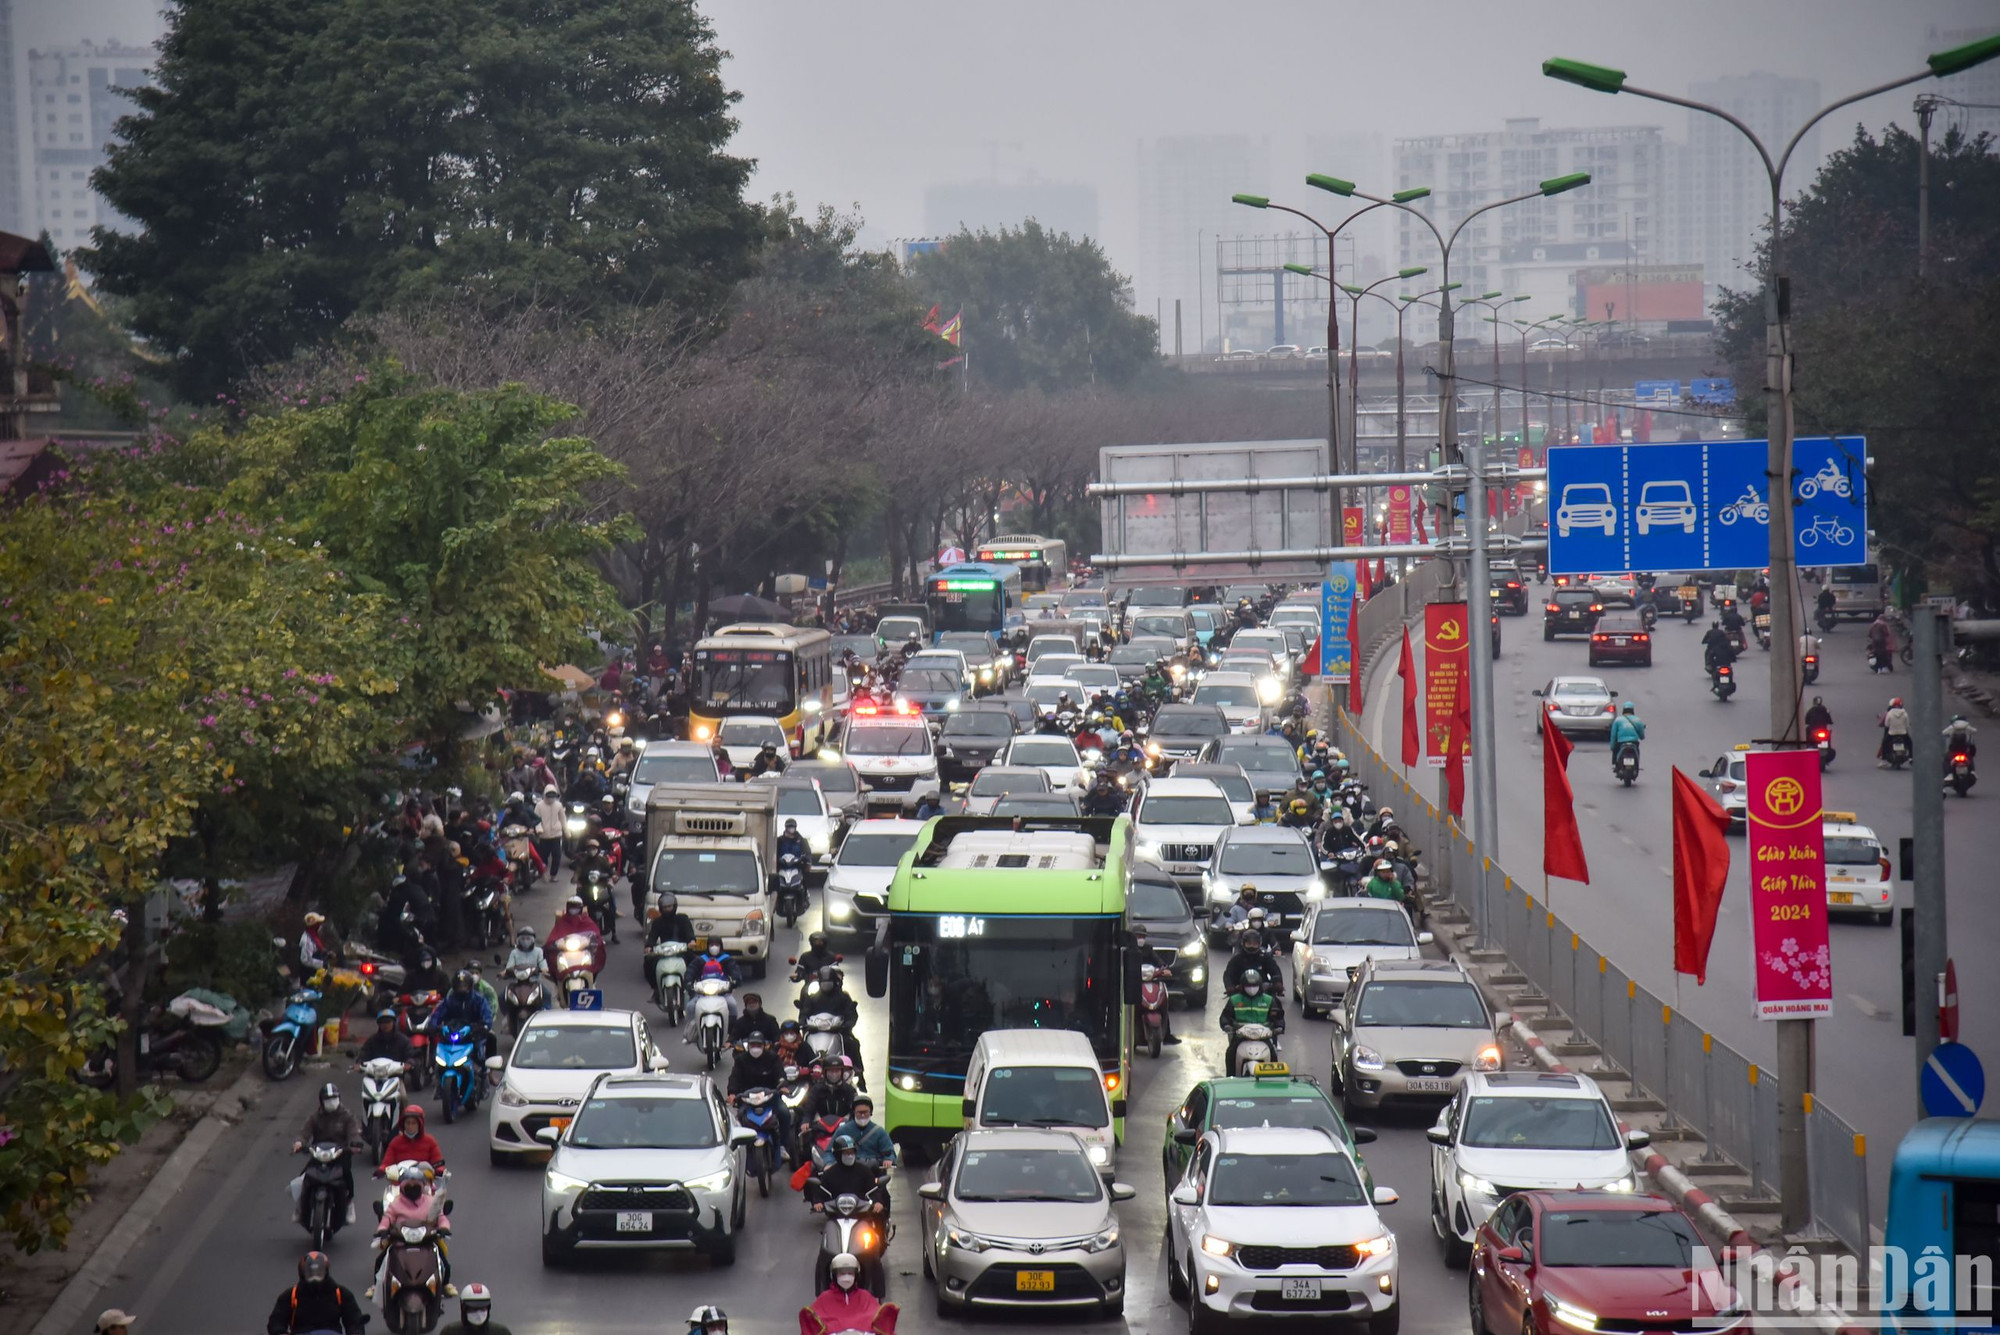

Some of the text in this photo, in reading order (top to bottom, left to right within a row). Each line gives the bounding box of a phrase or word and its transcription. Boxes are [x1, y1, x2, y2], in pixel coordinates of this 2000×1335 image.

[1757, 844, 1817, 862] Chào Xuân
[1761, 874, 1816, 895] Giáp Thìn
[1770, 903, 1811, 921] 2024
[1763, 1003, 1829, 1014] QUẬN HOÀNG MAI
[627, 1213, 642, 1222] 30G
[1293, 1280, 1310, 1289] 34A
